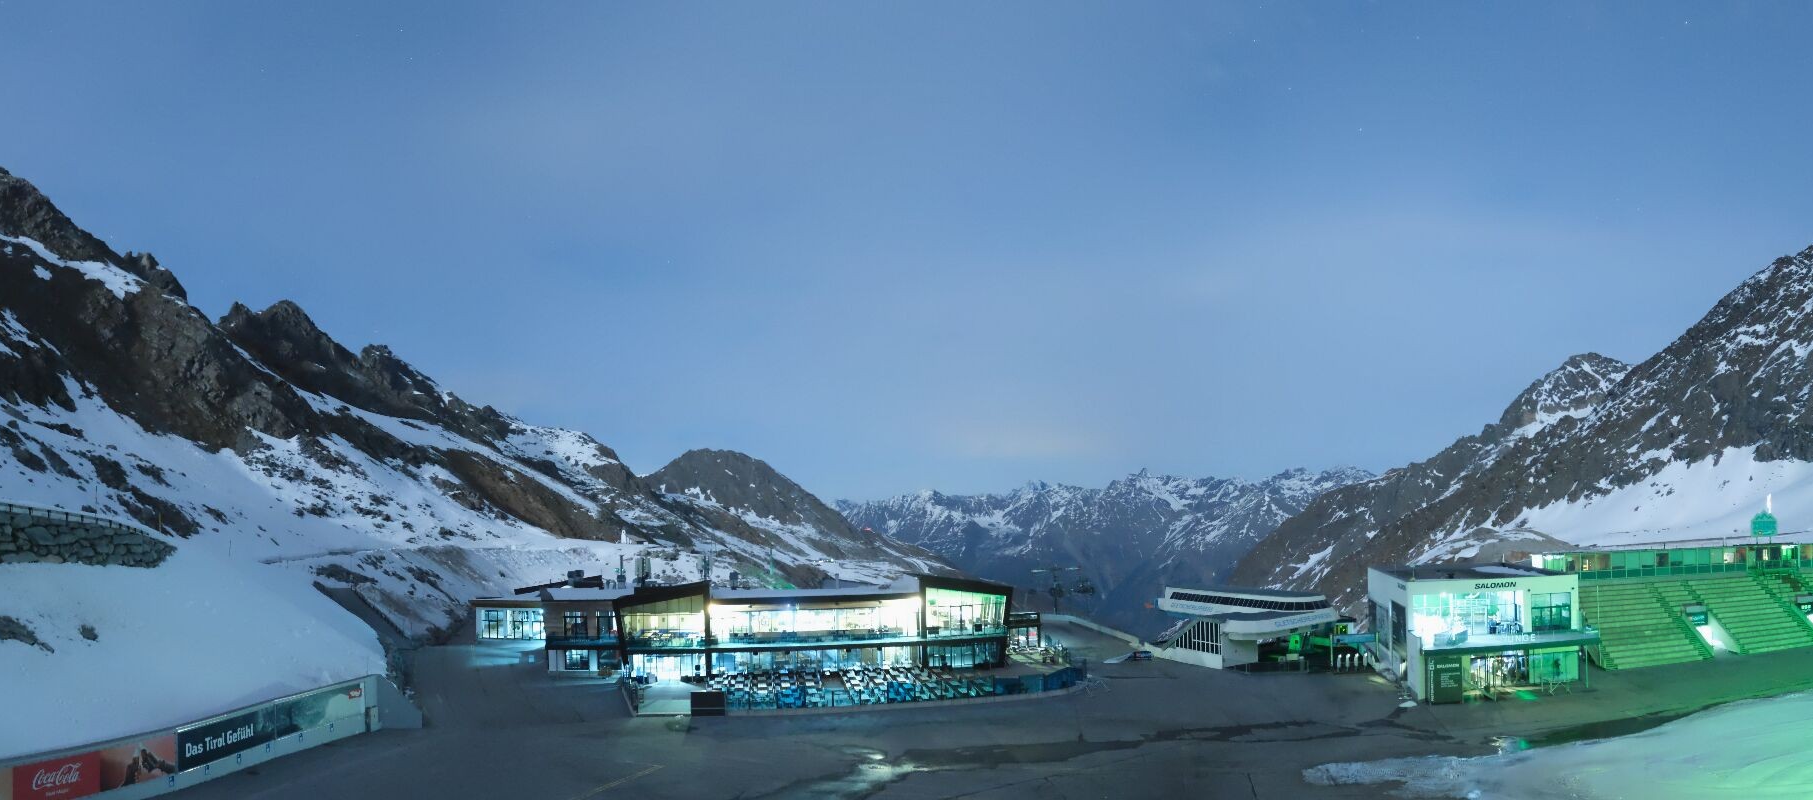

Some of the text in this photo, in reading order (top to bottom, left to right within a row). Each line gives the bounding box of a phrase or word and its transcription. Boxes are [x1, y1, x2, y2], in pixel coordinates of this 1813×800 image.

[1475, 581, 1517, 590] SALOMON
[185, 723, 254, 758] Das Tirol Gefühl
[32, 762, 83, 791] Coca-Cola
